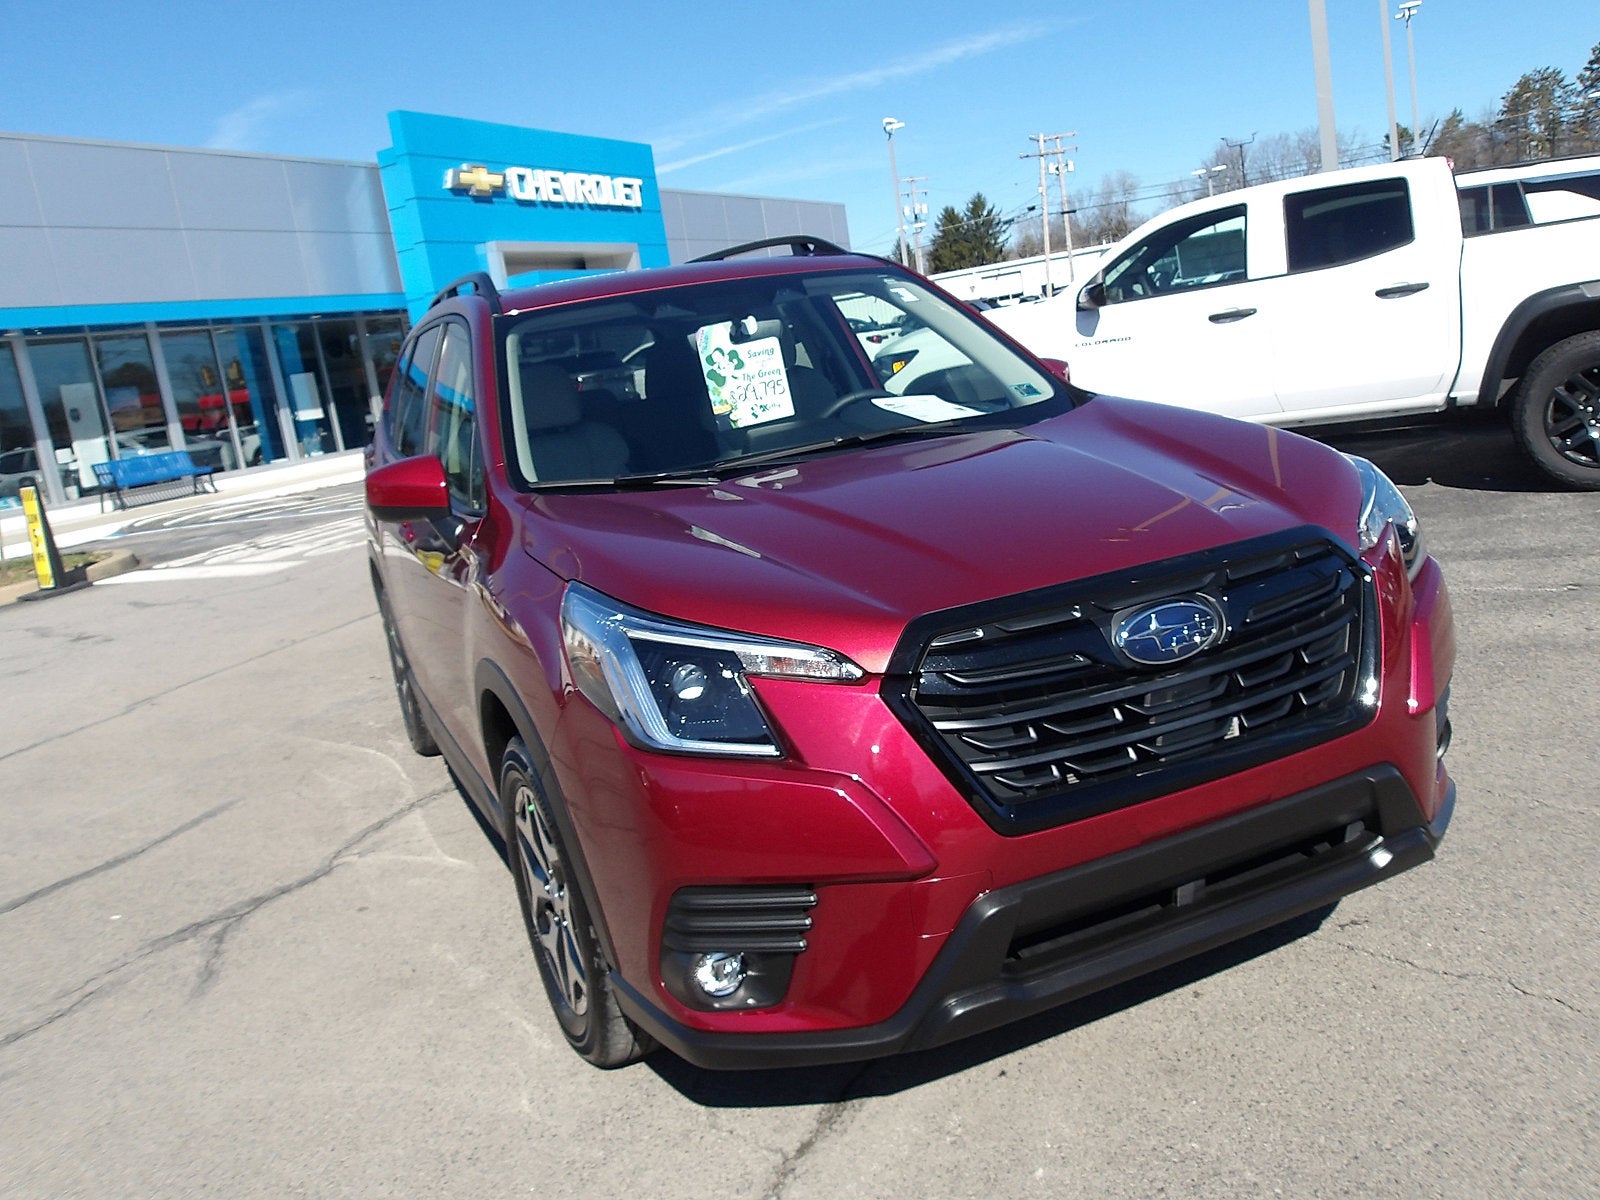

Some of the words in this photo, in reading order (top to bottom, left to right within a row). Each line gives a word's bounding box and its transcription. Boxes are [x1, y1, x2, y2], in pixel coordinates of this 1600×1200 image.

[506, 167, 642, 207] CHEVROLET
[747, 347, 775, 359] Saving
[757, 368, 782, 379] Green
